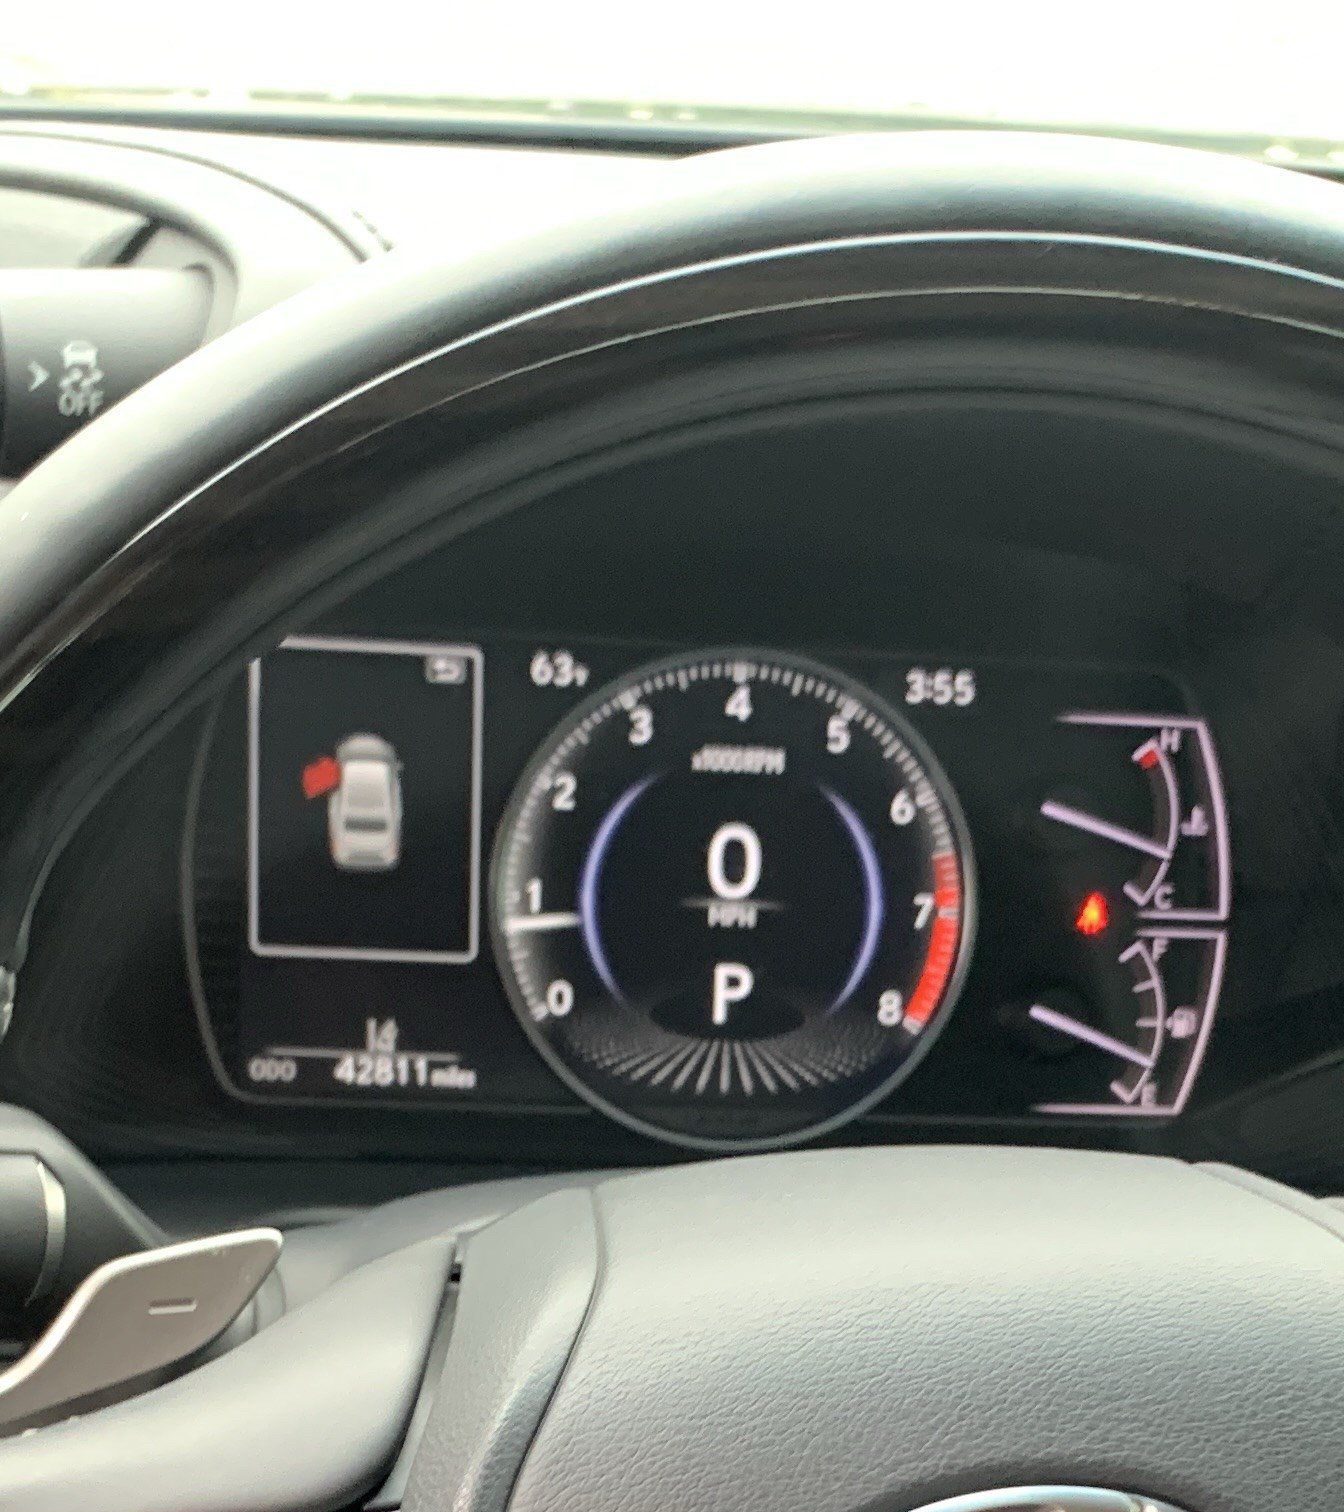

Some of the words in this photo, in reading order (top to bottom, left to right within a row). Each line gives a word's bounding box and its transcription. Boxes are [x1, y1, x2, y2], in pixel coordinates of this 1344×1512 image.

[725, 686, 752, 722] 4
[905, 669, 976, 705] 3:55
[628, 710, 654, 745] 3
[826, 718, 851, 754] 5
[552, 774, 577, 810] 2
[890, 790, 916, 825] 6
[707, 821, 762, 899] 0
[525, 879, 544, 911] 1
[912, 895, 936, 930] 7
[546, 981, 574, 1016] 0
[711, 962, 755, 1025] P
[877, 990, 903, 1026] 8
[333, 1051, 428, 1087] 42811
